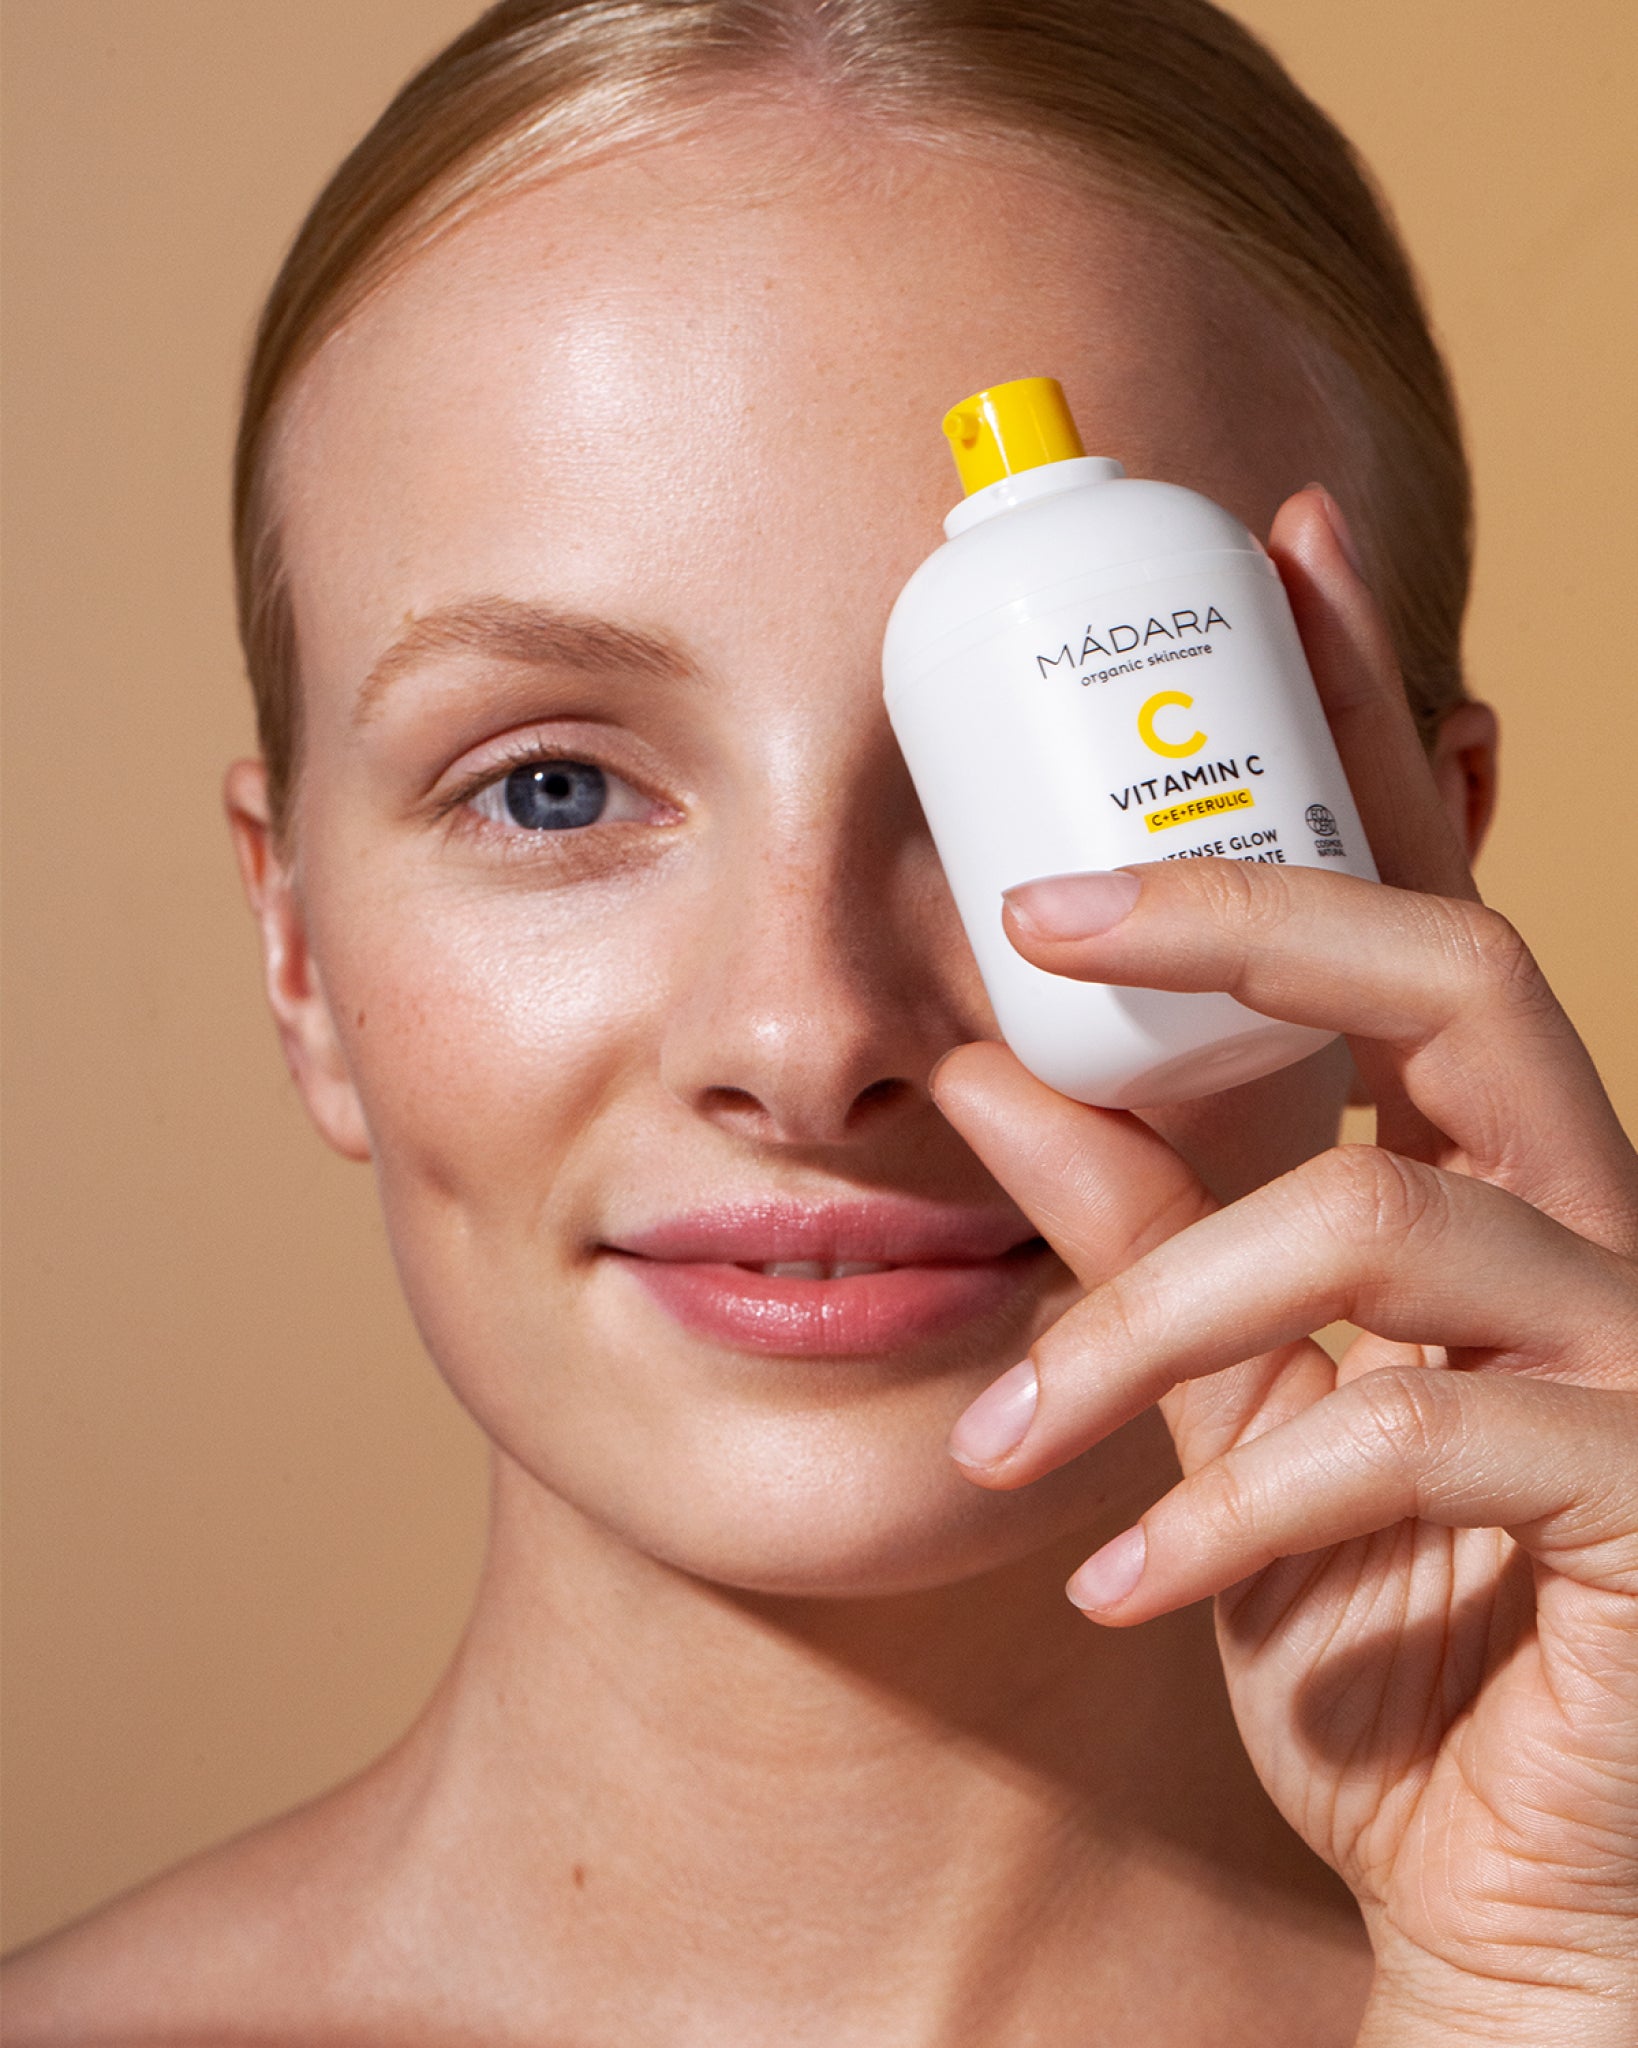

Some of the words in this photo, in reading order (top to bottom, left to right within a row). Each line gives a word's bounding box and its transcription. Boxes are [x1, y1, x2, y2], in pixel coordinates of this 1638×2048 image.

[1036, 606, 1232, 680] MÁDARA
[1081, 658, 1144, 687] organic
[1147, 642, 1213, 667] skincare
[1137, 690, 1208, 759] C
[1110, 758, 1240, 811] VITAMIN
[1246, 755, 1265, 776] C
[1151, 791, 1249, 827] C+E+FERULIC
[1229, 829, 1278, 851] GLOW
